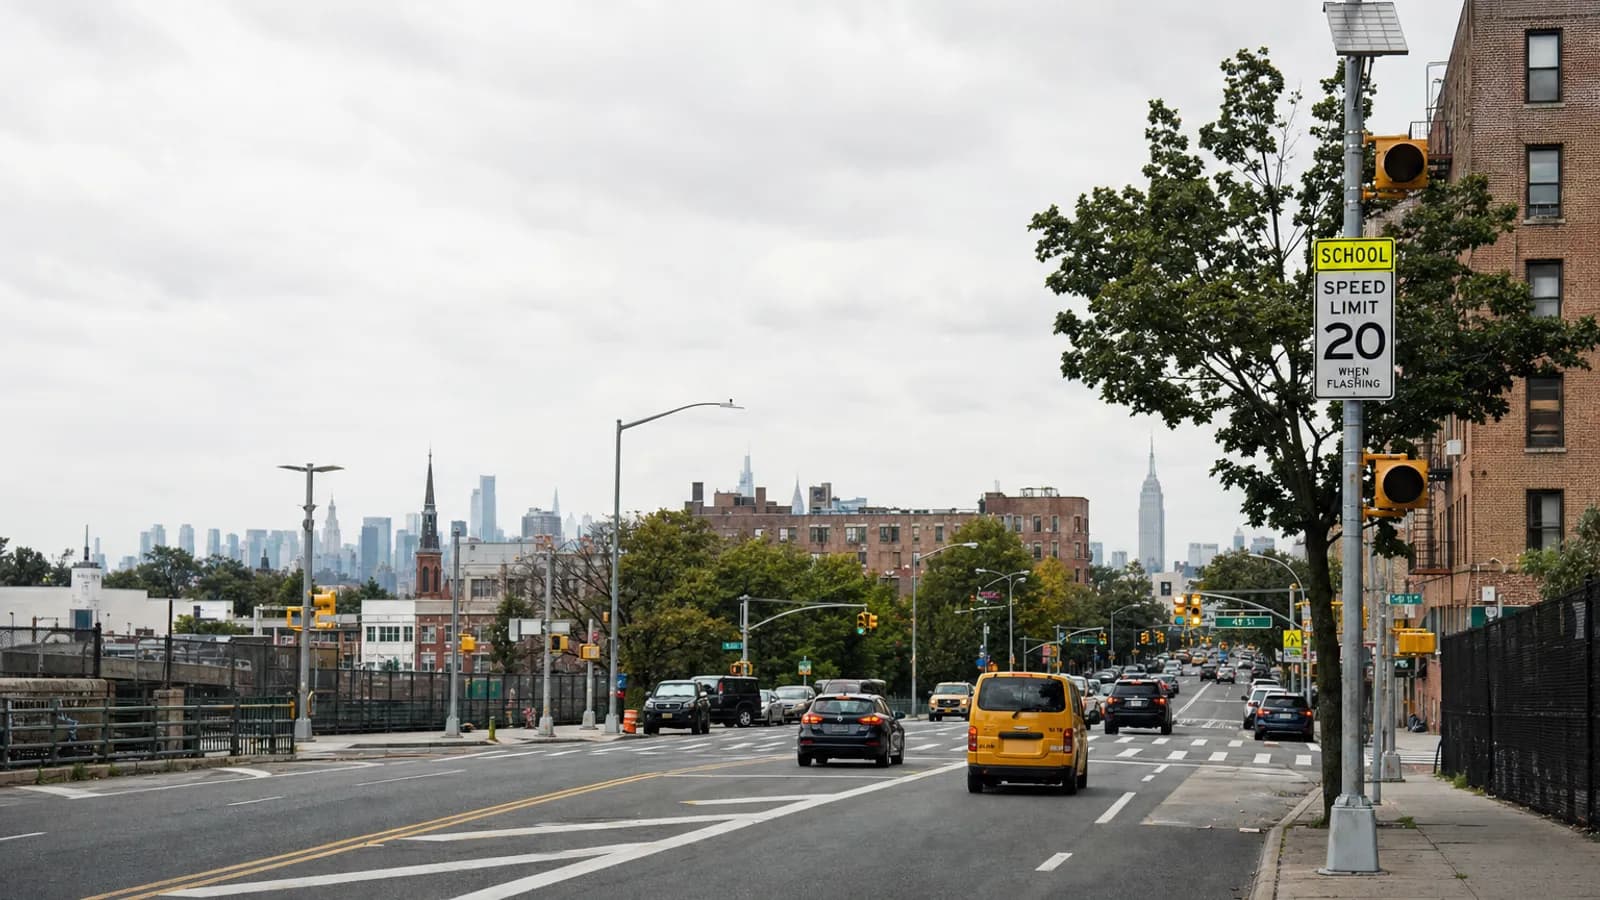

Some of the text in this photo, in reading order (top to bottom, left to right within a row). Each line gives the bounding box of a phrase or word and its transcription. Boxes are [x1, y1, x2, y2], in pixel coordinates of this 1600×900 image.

[1321, 247, 1388, 263] SCHOOL
[1323, 280, 1386, 294] SPEED
[1330, 301, 1379, 314] LIMIT
[1323, 322, 1386, 360] 20
[1338, 367, 1369, 377] WHEN
[1327, 379, 1380, 389] FLASHING
